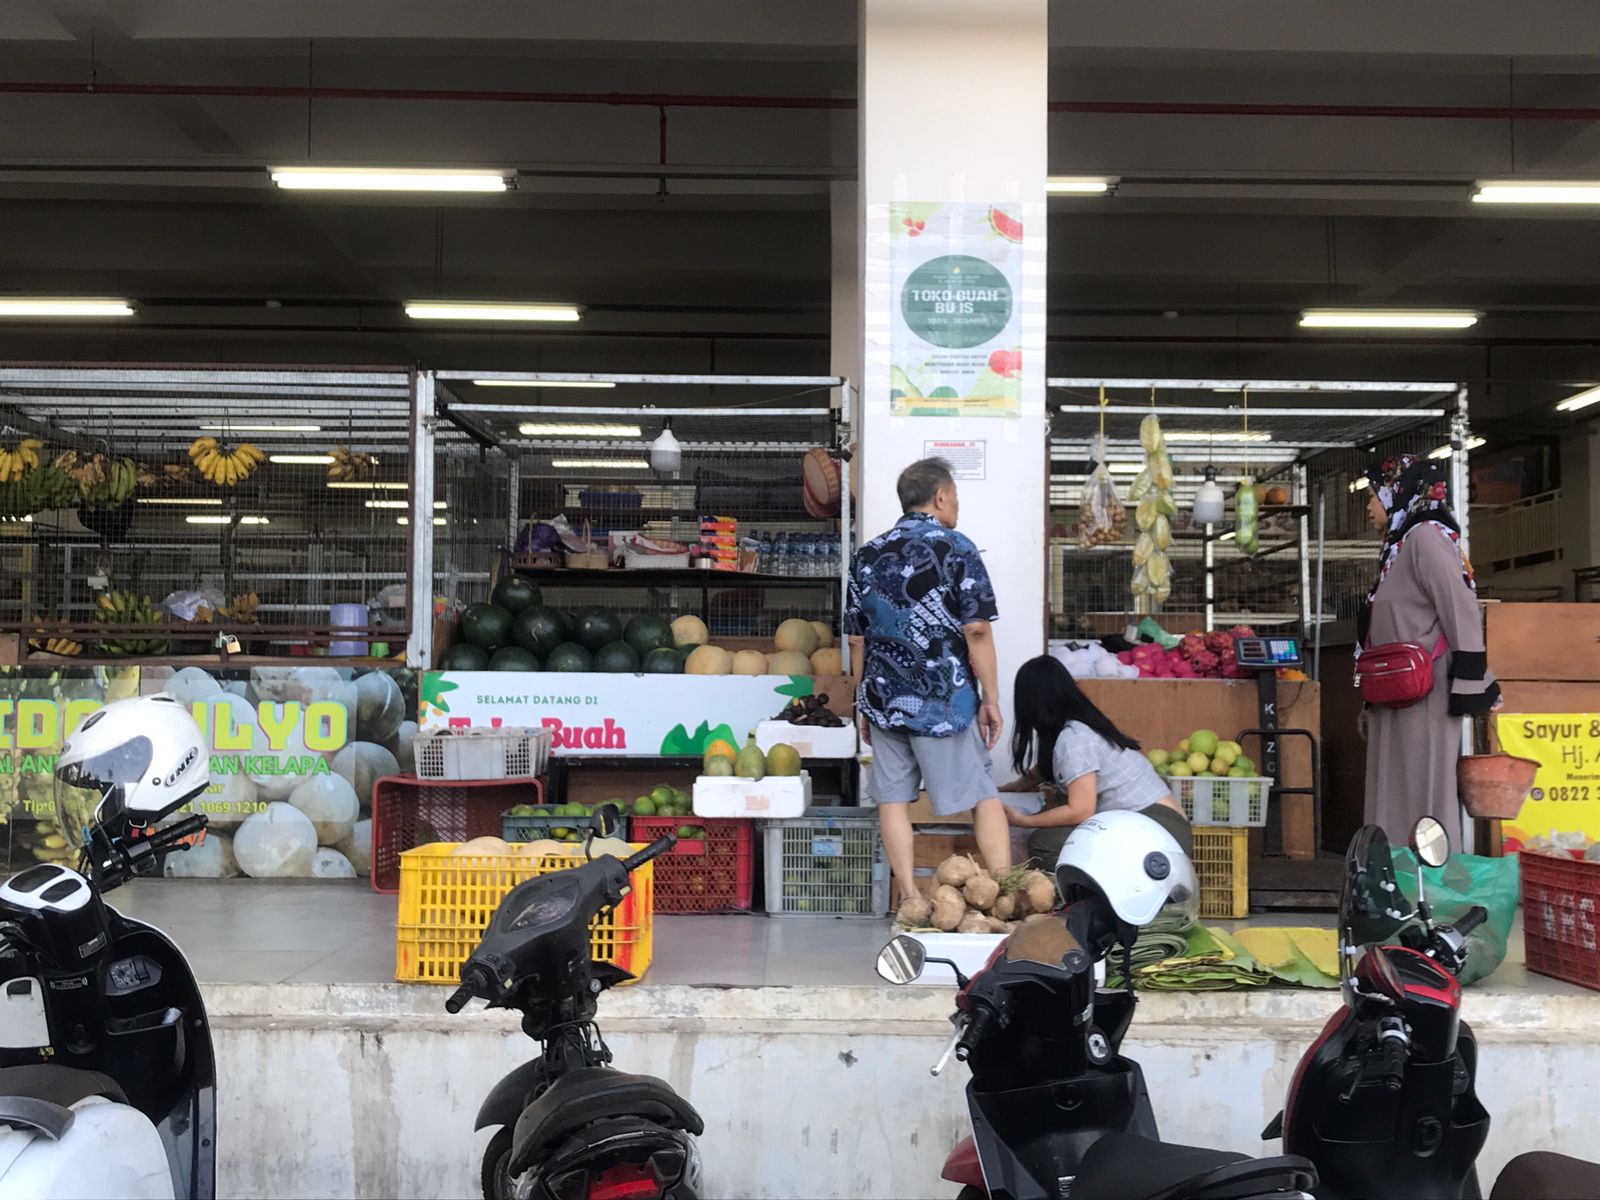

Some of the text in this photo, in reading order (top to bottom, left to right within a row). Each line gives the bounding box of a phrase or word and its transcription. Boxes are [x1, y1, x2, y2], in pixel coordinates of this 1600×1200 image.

[912, 290, 998, 302] TOKO BUAH
[935, 302, 974, 314] BU IS
[477, 695, 599, 705] SELAMAT DATANG DI
[541, 717, 627, 750] Buah
[1523, 720, 1600, 742] Sayur &
[244, 756, 331, 775] KELAPA
[1562, 745, 1589, 769] Hj.
[169, 751, 194, 783] INK
[1549, 786, 1590, 801] 0822
[200, 802, 231, 813] 1069
[236, 802, 268, 813] 1210
